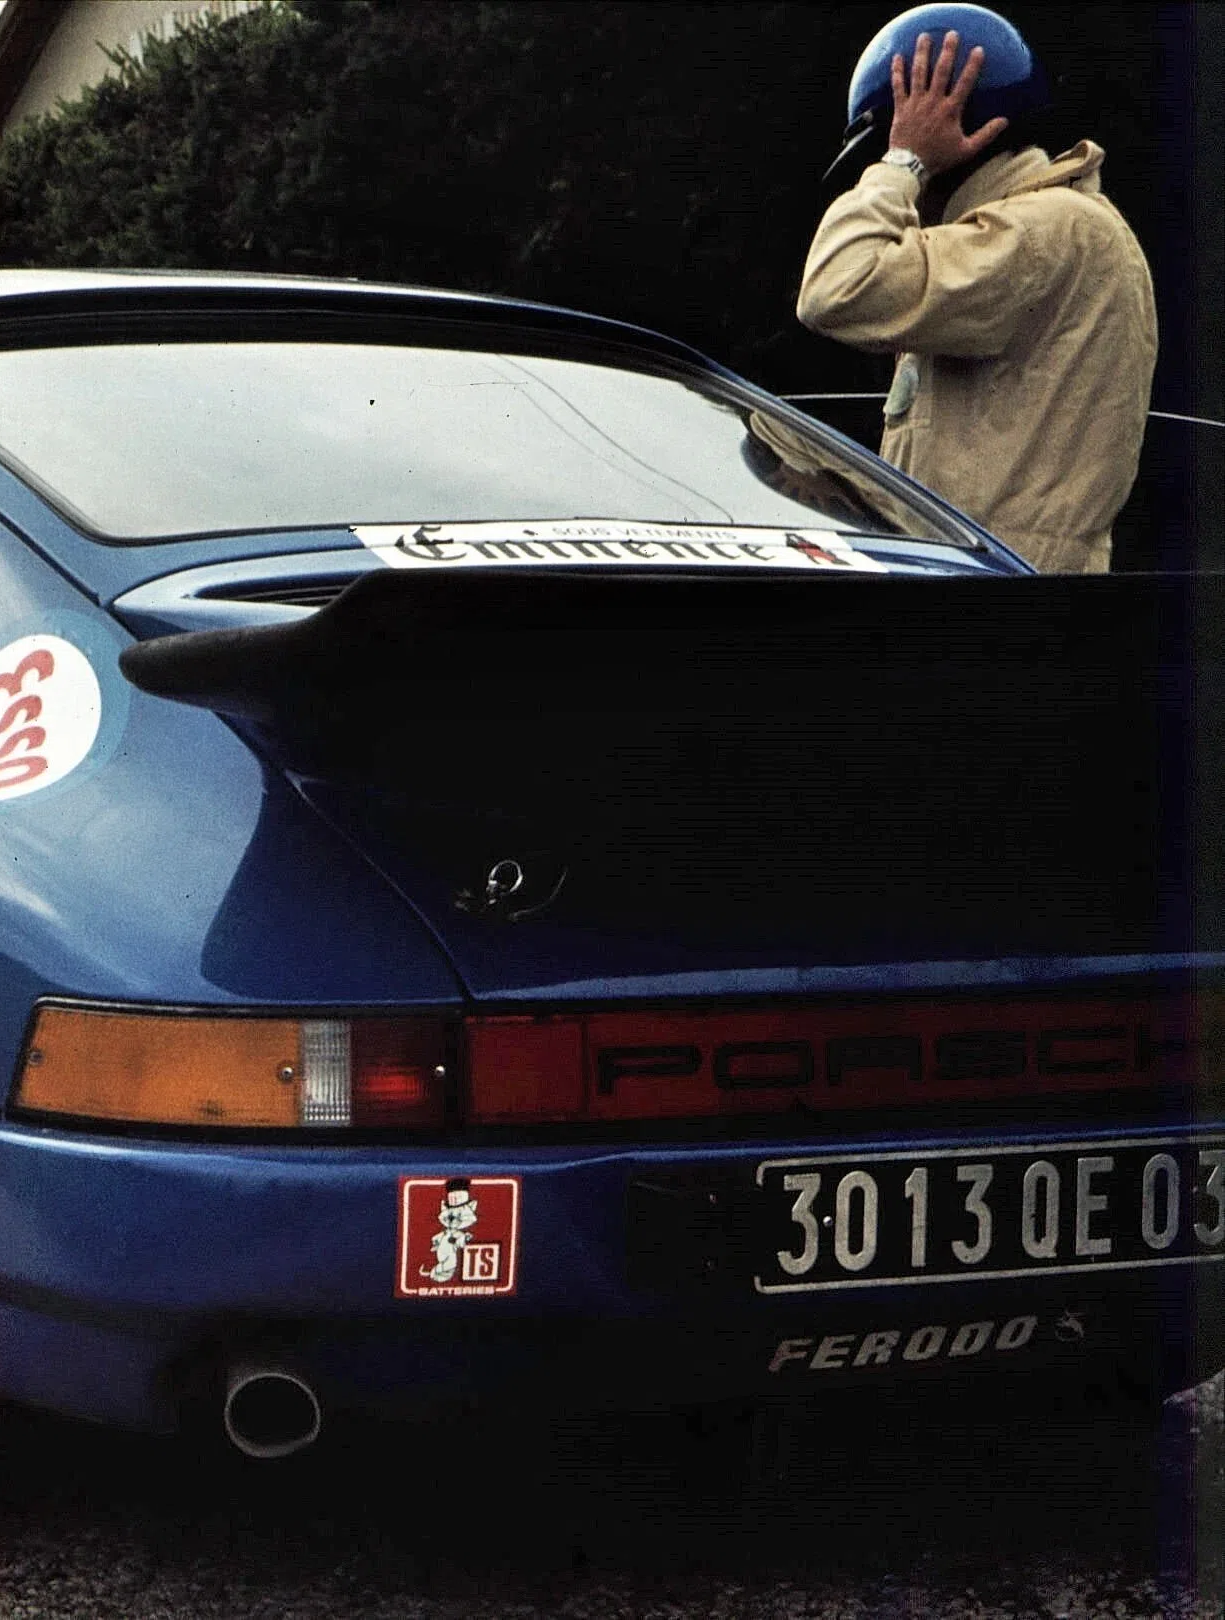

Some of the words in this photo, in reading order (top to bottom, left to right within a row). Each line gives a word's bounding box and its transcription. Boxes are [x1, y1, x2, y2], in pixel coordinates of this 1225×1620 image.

[394, 526, 777, 562] Eminence
[777, 1163, 996, 1276] 3013
[1021, 1155, 1116, 1259] QE
[1141, 1149, 1225, 1250] 03
[467, 1247, 495, 1278] TS
[418, 1286, 495, 1296] BATTERIES
[768, 1317, 1038, 1373] FERODO
